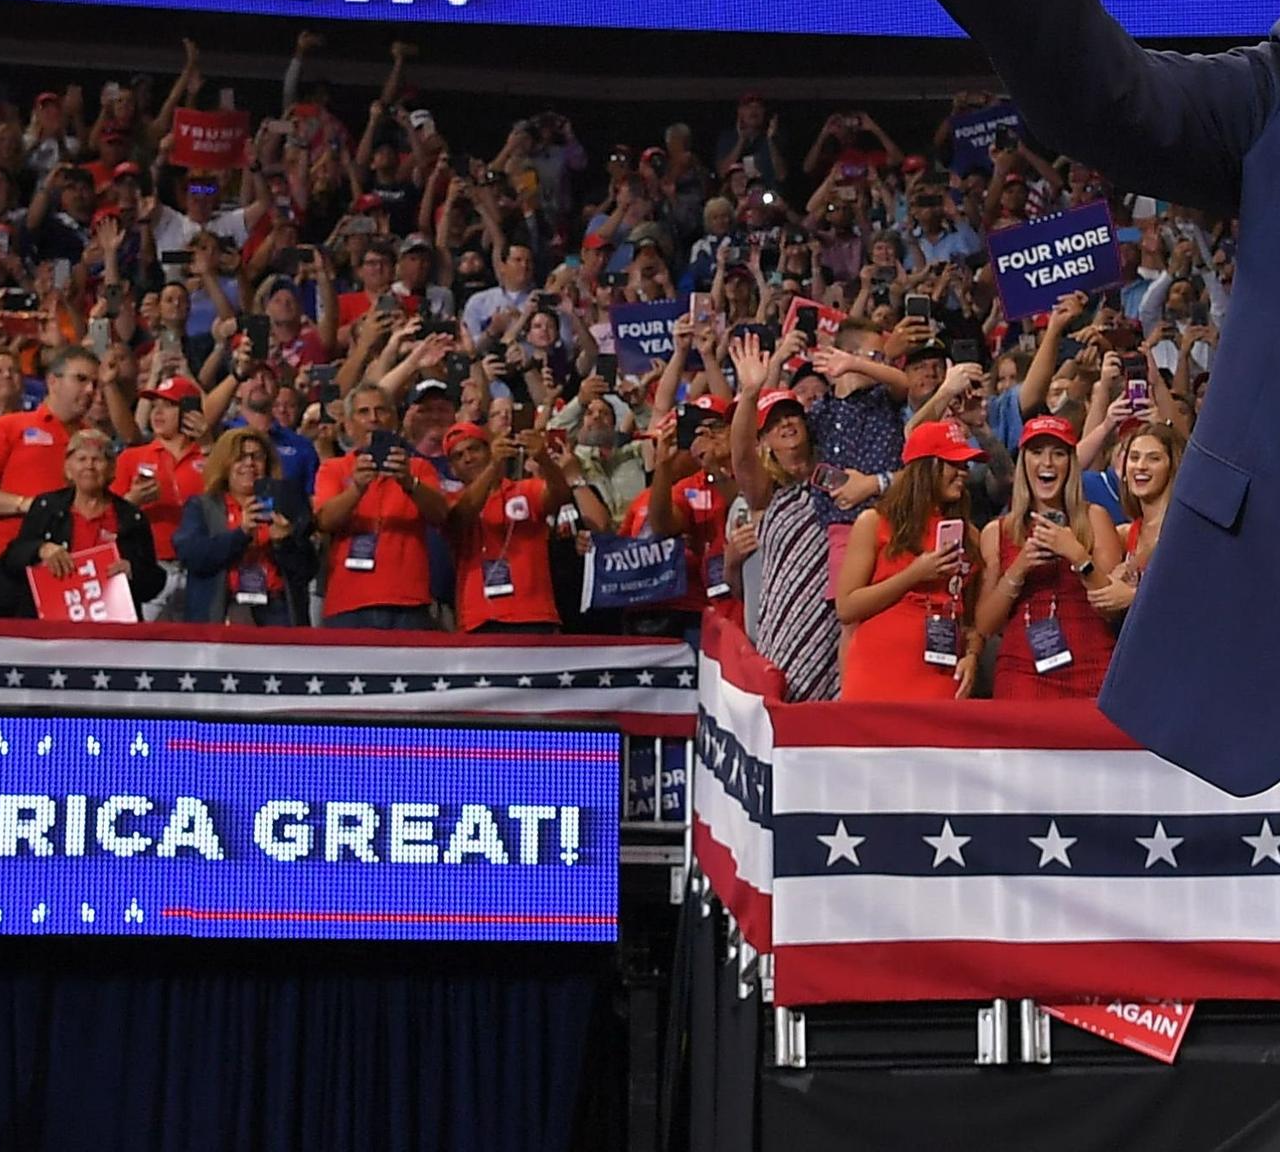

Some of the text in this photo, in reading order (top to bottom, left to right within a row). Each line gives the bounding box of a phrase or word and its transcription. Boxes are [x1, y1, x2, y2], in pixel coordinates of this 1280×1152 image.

[179, 123, 245, 139] TRUMP
[954, 122, 986, 138] FOUR
[971, 134, 997, 149] YEA
[997, 225, 1111, 275] FOUR MORE
[1024, 255, 1095, 289] YEARS!
[618, 320, 666, 340] FOUR
[639, 338, 674, 355] YEA
[603, 537, 675, 572] TRUMP
[64, 590, 86, 622] 20
[77, 560, 107, 622] TRU
[641, 768, 686, 792] MOR
[252, 799, 581, 867] GREAT!
[1106, 1001, 1178, 1038] AGAIN
